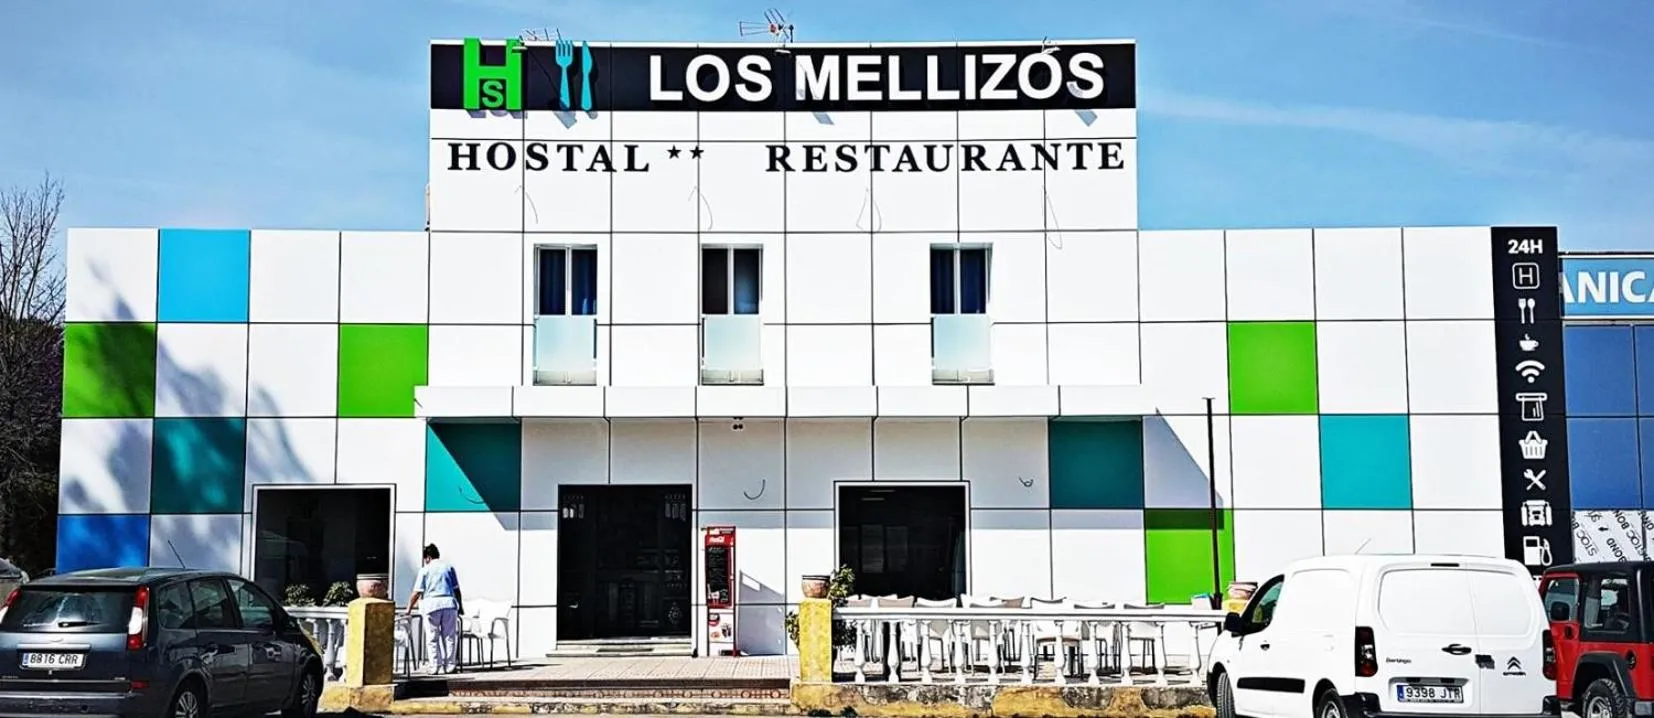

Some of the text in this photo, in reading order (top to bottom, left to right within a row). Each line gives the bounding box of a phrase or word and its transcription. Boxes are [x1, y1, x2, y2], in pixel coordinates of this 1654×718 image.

[650, 52, 1104, 102] LOS MELLIZOS
[447, 142, 1125, 173] HOSTAL RESTAURANTE
[1507, 239, 1543, 254] 24H
[1562, 271, 1654, 303] NIC
[1406, 687, 1436, 698] 9398
